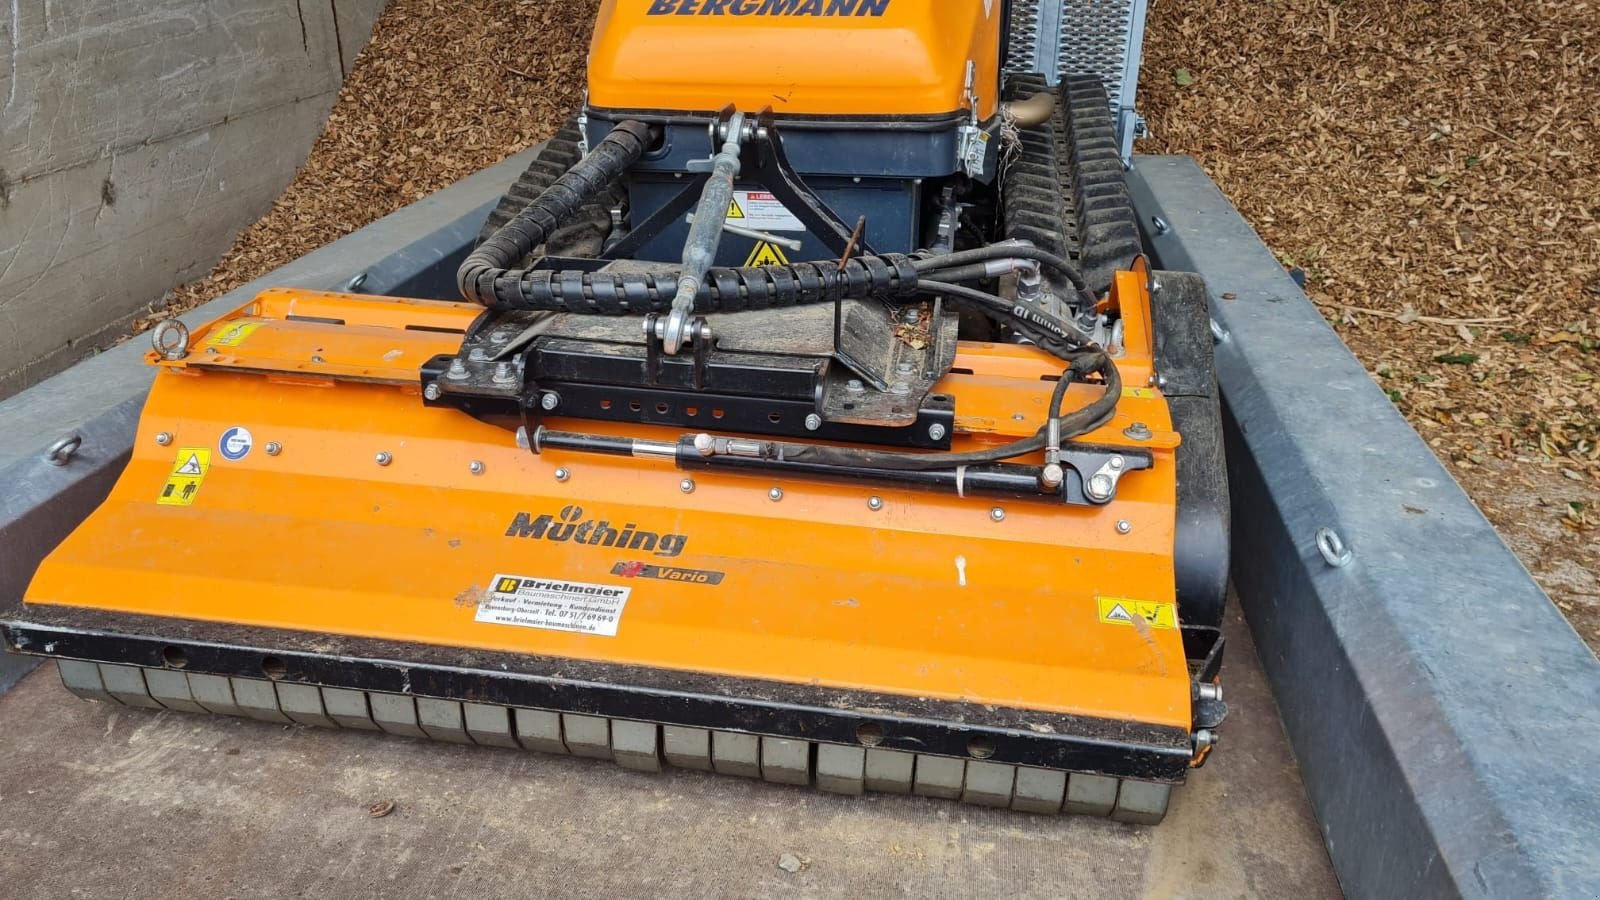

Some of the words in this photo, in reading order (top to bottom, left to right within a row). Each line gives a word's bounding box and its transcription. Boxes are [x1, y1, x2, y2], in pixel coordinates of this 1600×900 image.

[647, 0, 890, 16] BERGMANN
[657, 567, 709, 583] Vario
[522, 579, 624, 597] Brielmaier
[523, 598, 563, 609] Vermietung
[569, 603, 617, 614] Kundendienst
